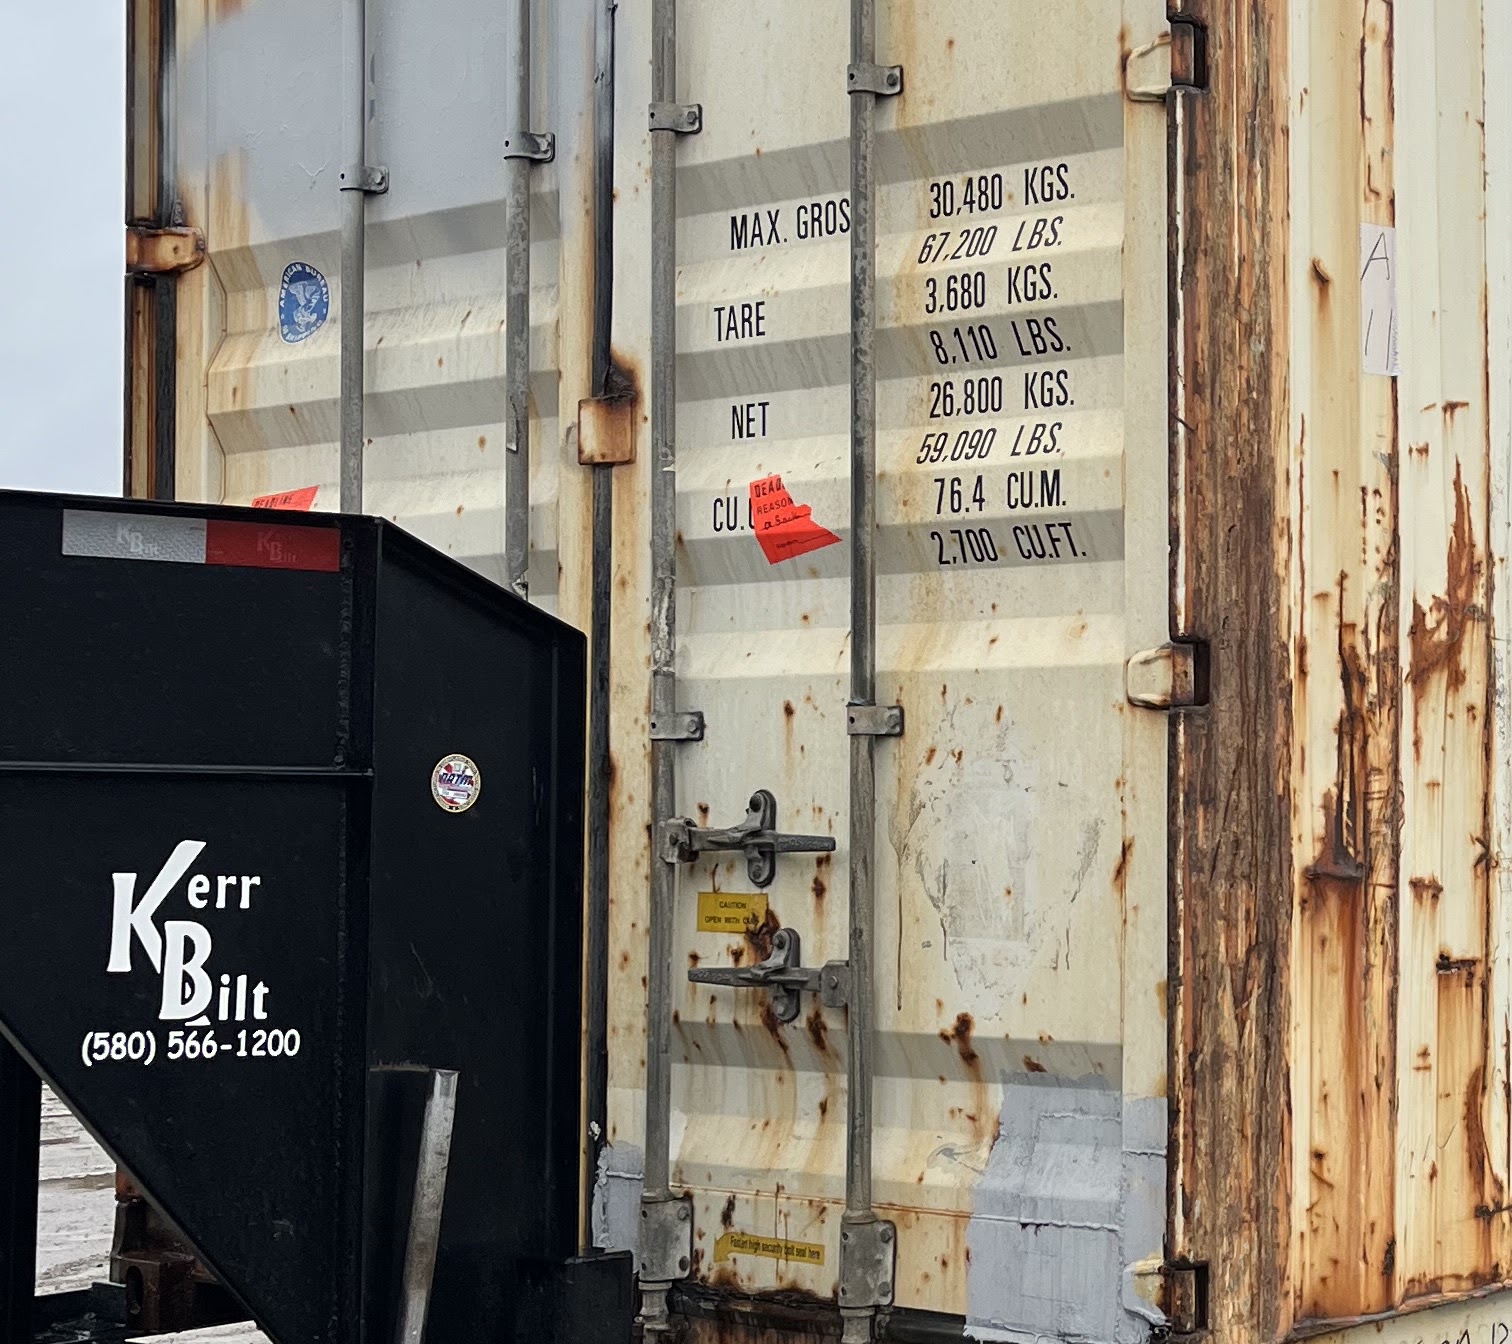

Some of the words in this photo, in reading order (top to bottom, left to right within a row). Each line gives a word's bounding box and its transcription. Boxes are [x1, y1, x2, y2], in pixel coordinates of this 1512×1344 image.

[730, 209, 788, 250] MAX.
[796, 198, 851, 240] GROS
[929, 173, 1003, 219] 30,480
[1024, 163, 1075, 205] KGS.
[917, 225, 998, 265] 67,200
[1011, 215, 1064, 253] LBS.
[714, 301, 767, 342] TARE
[925, 271, 986, 314] 3,680
[1007, 263, 1058, 304] KGS.
[930, 324, 998, 366] 8,110
[1010, 316, 1071, 358] LBS.
[731, 402, 770, 440] NET
[929, 376, 1003, 419] 26,800
[1024, 369, 1075, 411] KGS.
[915, 427, 997, 465] 59,090
[1010, 422, 1063, 458] LBS.
[712, 495, 754, 532] CU.
[933, 476, 986, 515] 76.4
[1007, 469, 1067, 509] CU.M.
[754, 477, 785, 498] DEAD
[930, 528, 999, 566] 2,700
[1015, 523, 1086, 560] CU.FT.
[107, 840, 260, 974] Kerr
[719, 901, 746, 909] CAUTION
[158, 920, 269, 1026] Bilt
[81, 1031, 156, 1066] (580)
[167, 1028, 301, 1060] 566-1200
